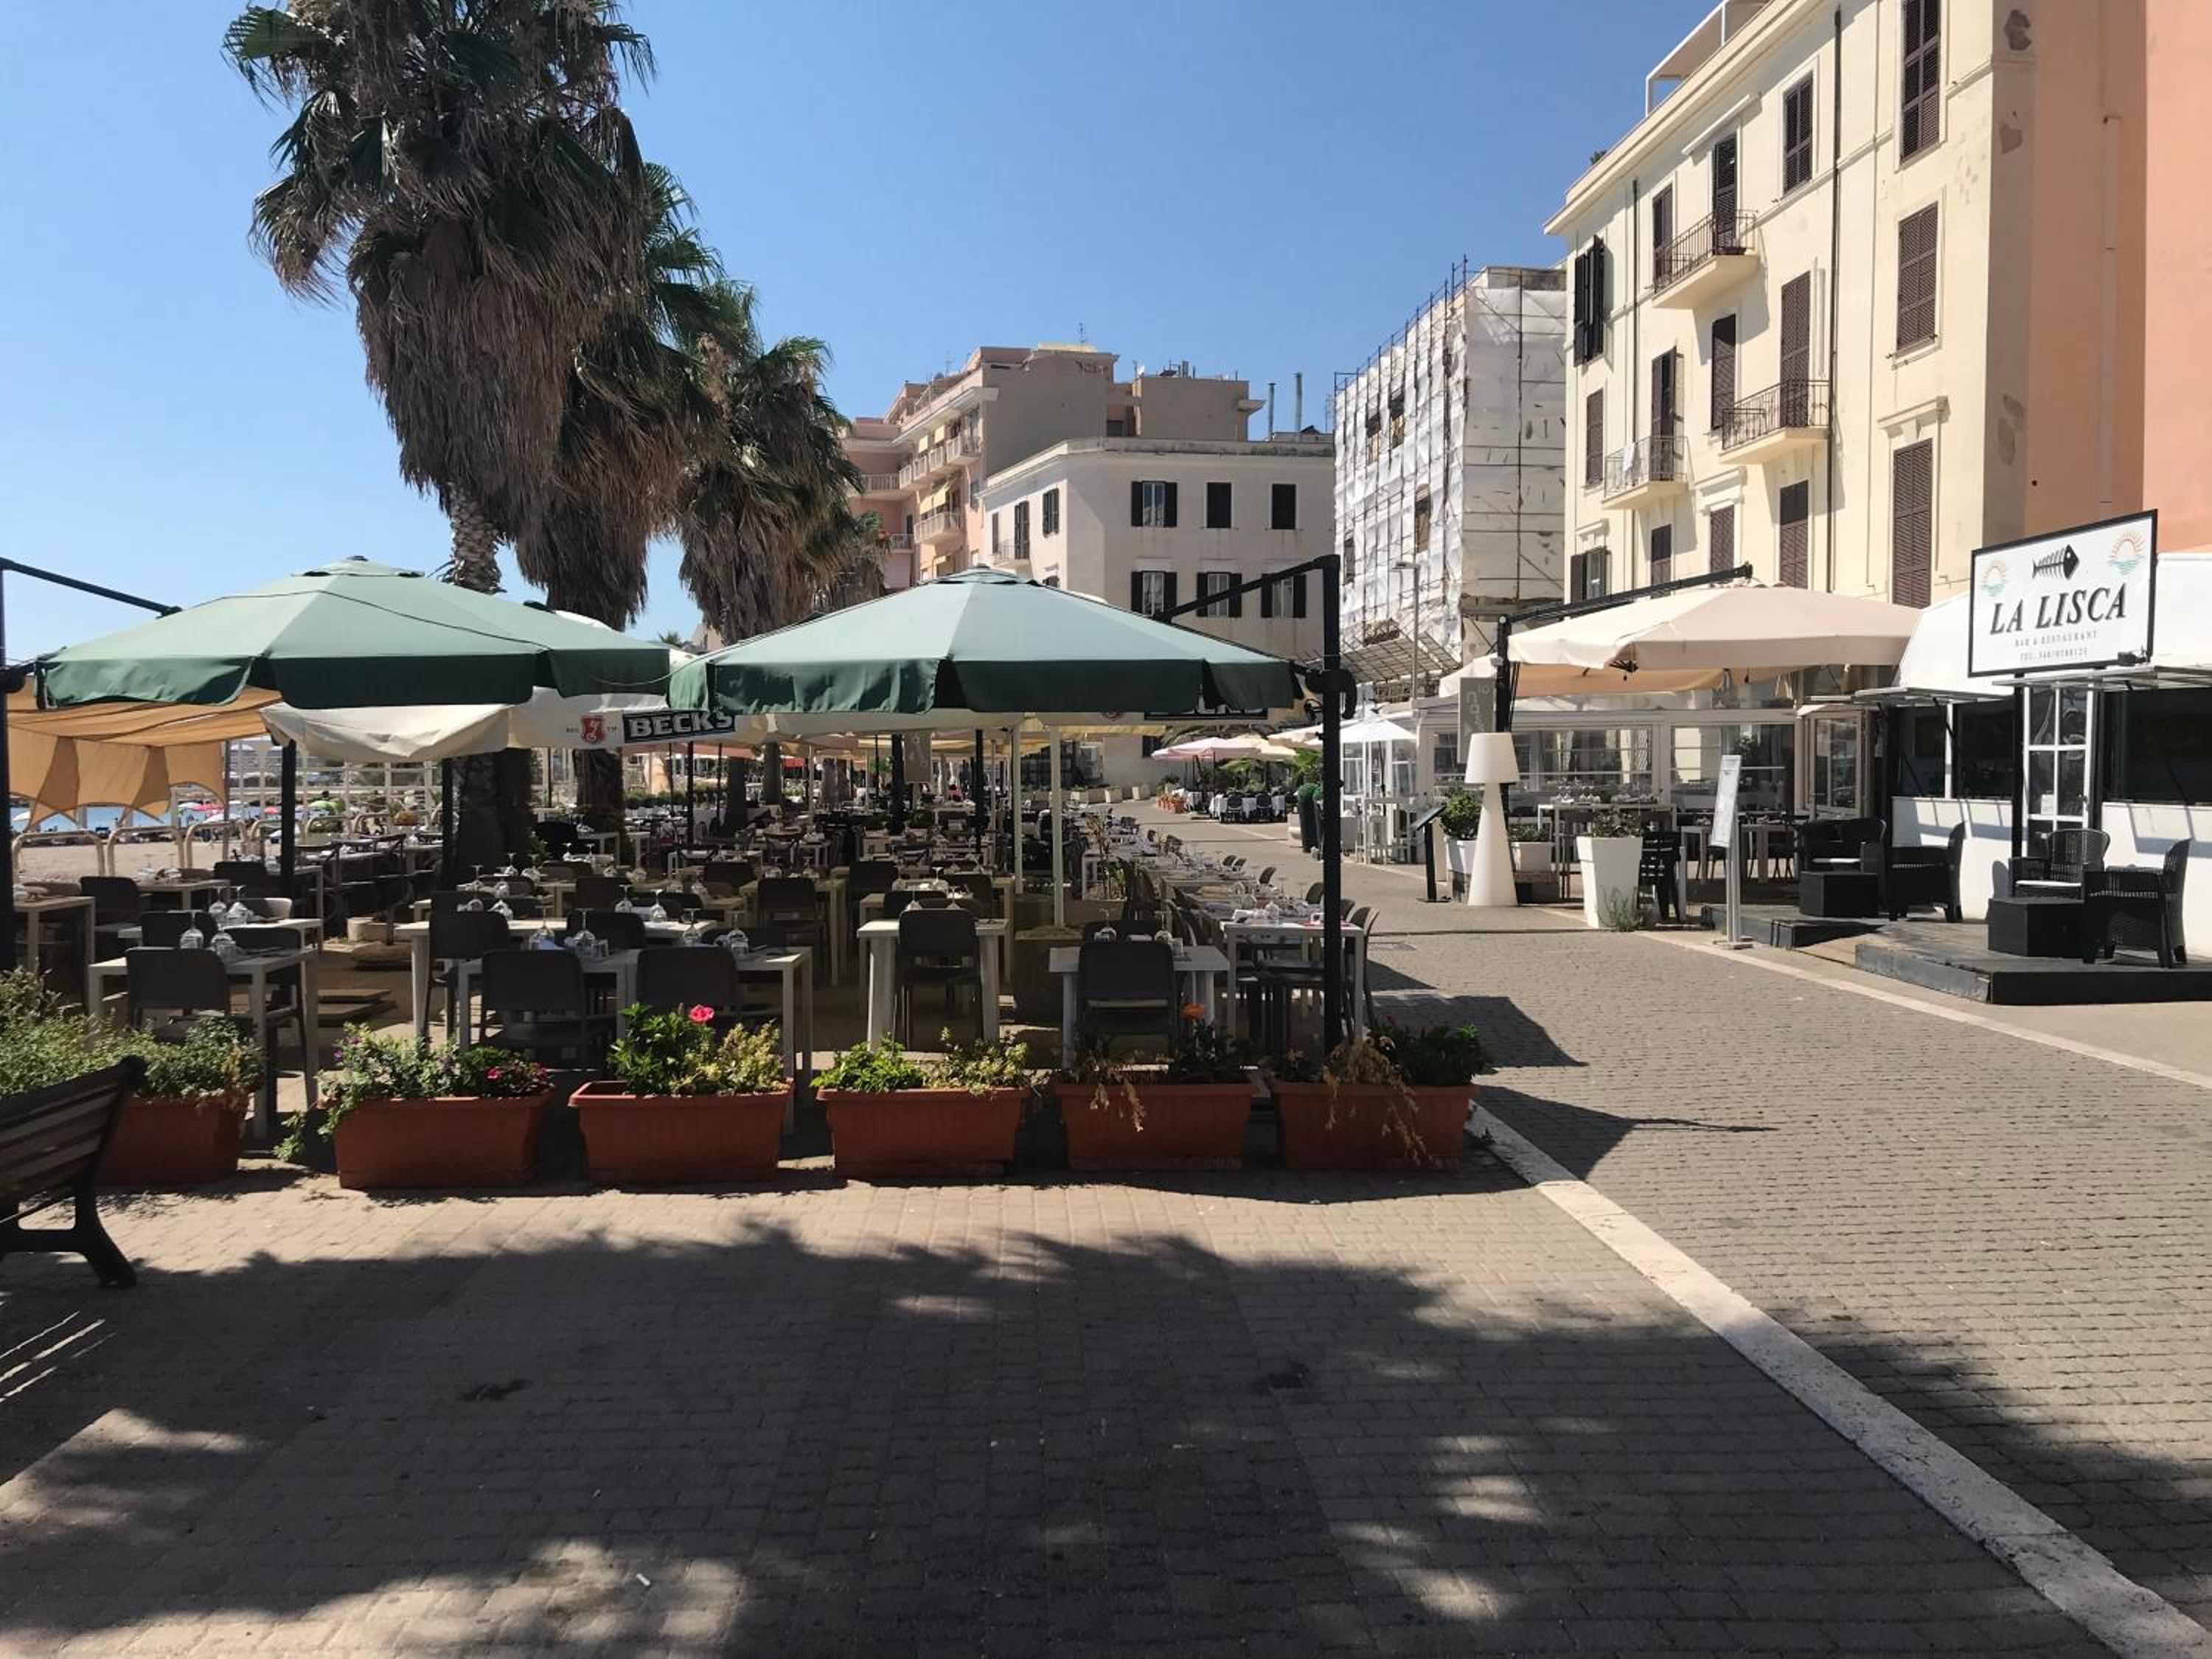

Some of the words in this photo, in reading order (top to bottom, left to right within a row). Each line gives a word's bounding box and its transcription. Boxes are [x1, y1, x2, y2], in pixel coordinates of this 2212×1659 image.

[1989, 598, 2023, 635] LA
[2036, 582, 2126, 629] LISCA
[2041, 630, 2097, 645] RESTAURANT
